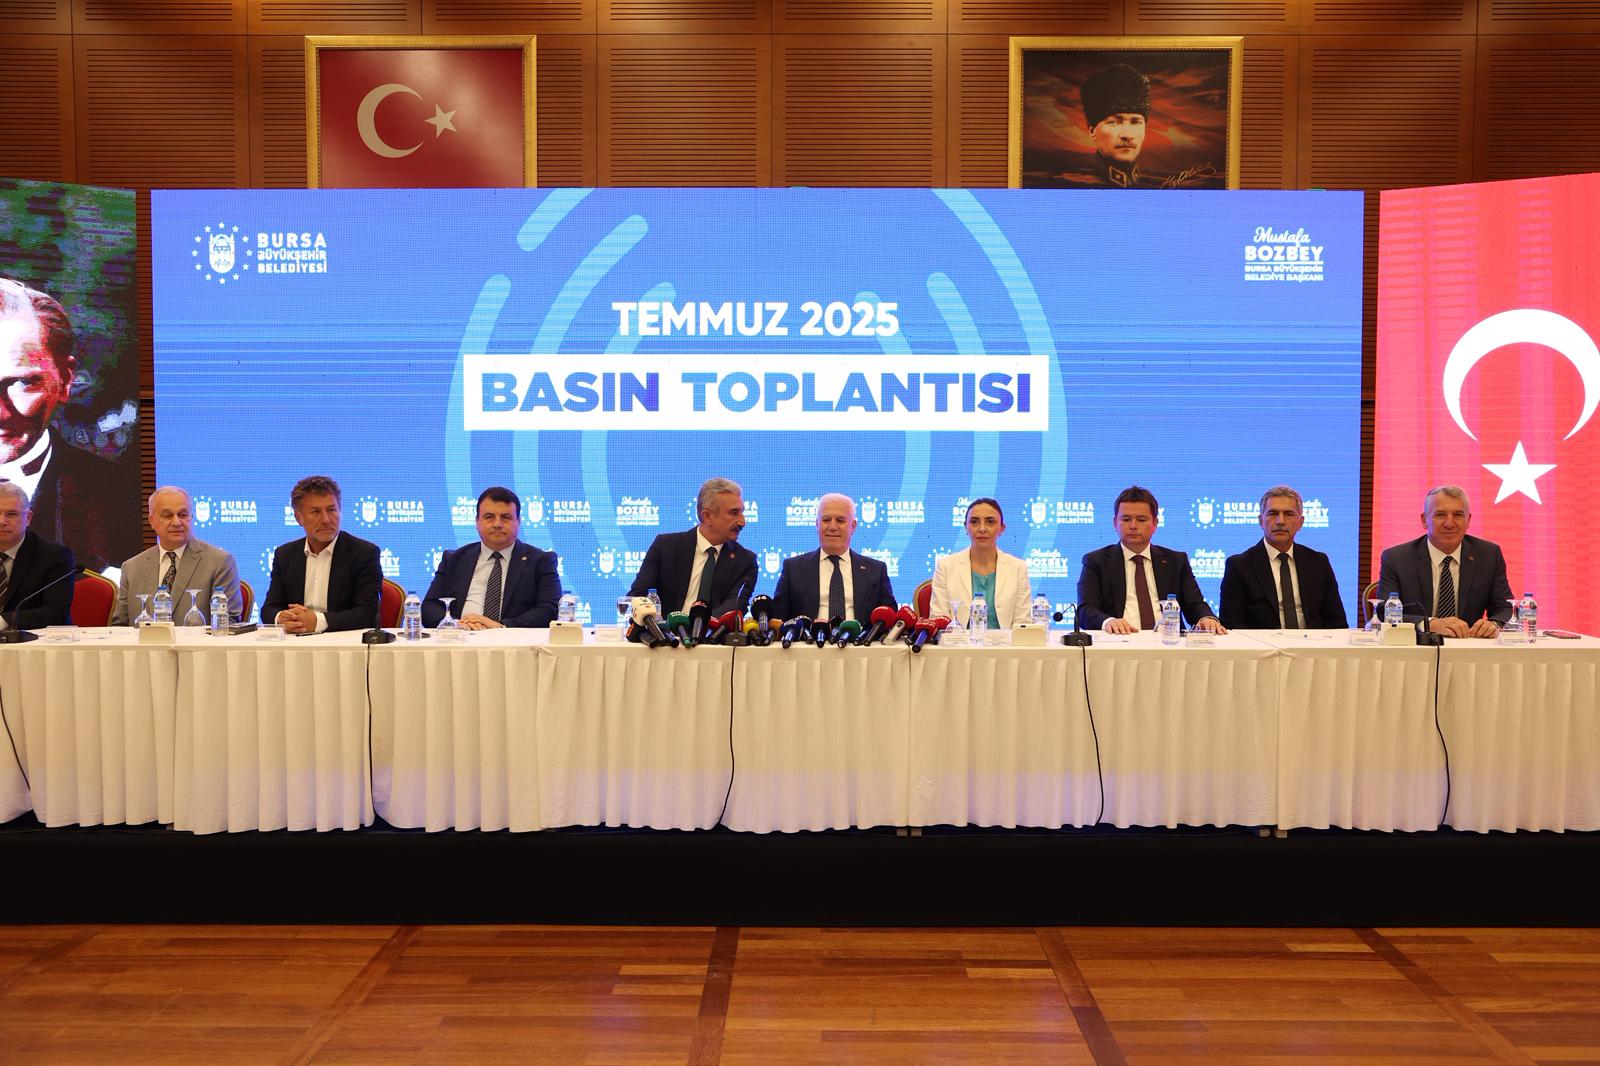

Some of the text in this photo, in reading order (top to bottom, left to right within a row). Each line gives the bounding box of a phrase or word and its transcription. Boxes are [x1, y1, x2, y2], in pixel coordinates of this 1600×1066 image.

[257, 232, 327, 248] BURSA
[1253, 226, 1311, 248] Mustafa
[257, 248, 327, 261] BÜYÜKŞEHİR
[1245, 245, 1324, 261] BOZBEY
[257, 261, 328, 273] BELEDİYESİ
[612, 302, 899, 337] TEMMUZ 2025
[481, 372, 1031, 413] BASIN TOPLANTISI
[220, 501, 257, 510] BURSA
[387, 501, 424, 510] BURSA
[553, 501, 591, 510] BURSA
[887, 501, 924, 510] BURSA
[1056, 502, 1094, 511] BURSA
